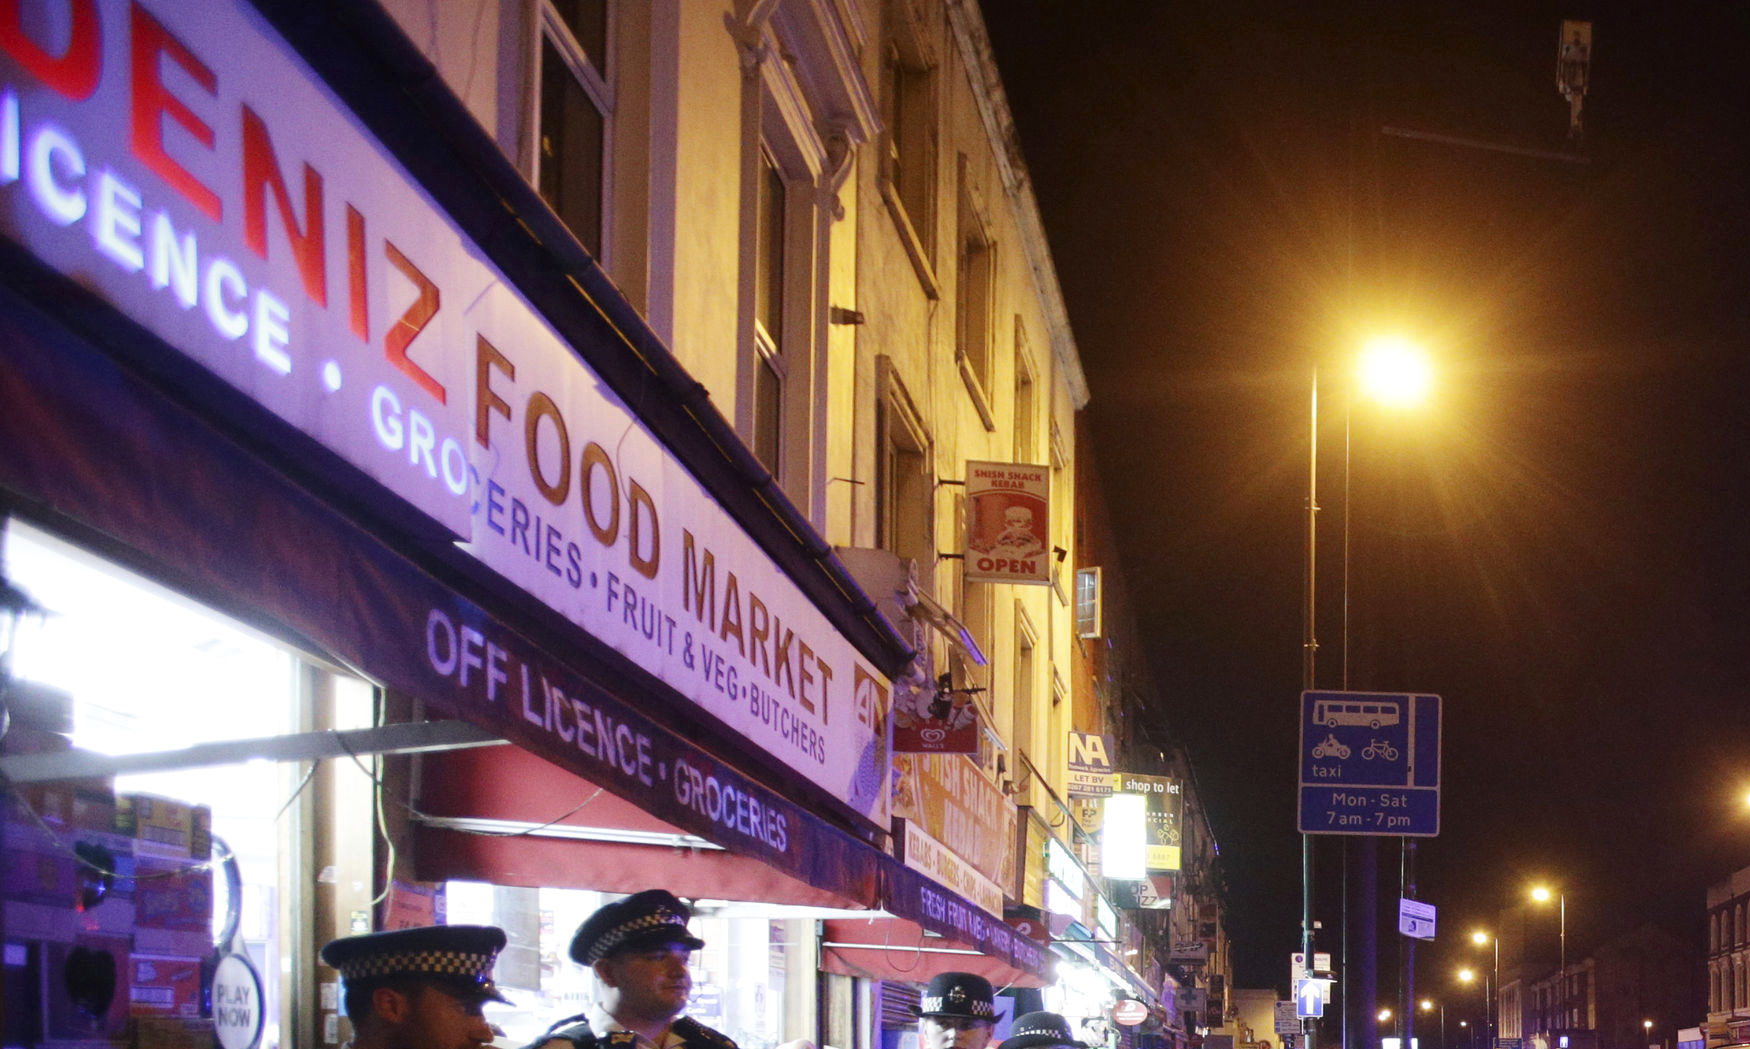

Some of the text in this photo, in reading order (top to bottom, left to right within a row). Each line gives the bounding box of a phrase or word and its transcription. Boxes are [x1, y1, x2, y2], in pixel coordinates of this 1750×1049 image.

[990, 479, 1025, 490] KEBAB
[1008, 471, 1042, 482] SHACK
[475, 330, 661, 580] FOOD
[681, 526, 833, 726] MARKET
[976, 557, 1036, 575] OPEN
[606, 570, 677, 655] FRUIT
[683, 630, 696, 667] &
[701, 643, 739, 702] VEG
[749, 693, 827, 768] BUTCHERS
[426, 608, 788, 853] OFF LICENCE GROCERIES
[1074, 774, 1105, 785] LET BY
[1312, 764, 1342, 777] taxi
[1126, 779, 1180, 795] shop to let
[1332, 792, 1367, 806] Mon
[1380, 793, 1408, 808] Sat
[920, 886, 946, 923] FRESH
[216, 984, 250, 1005] PLAY
[218, 1006, 250, 1028] NOW
